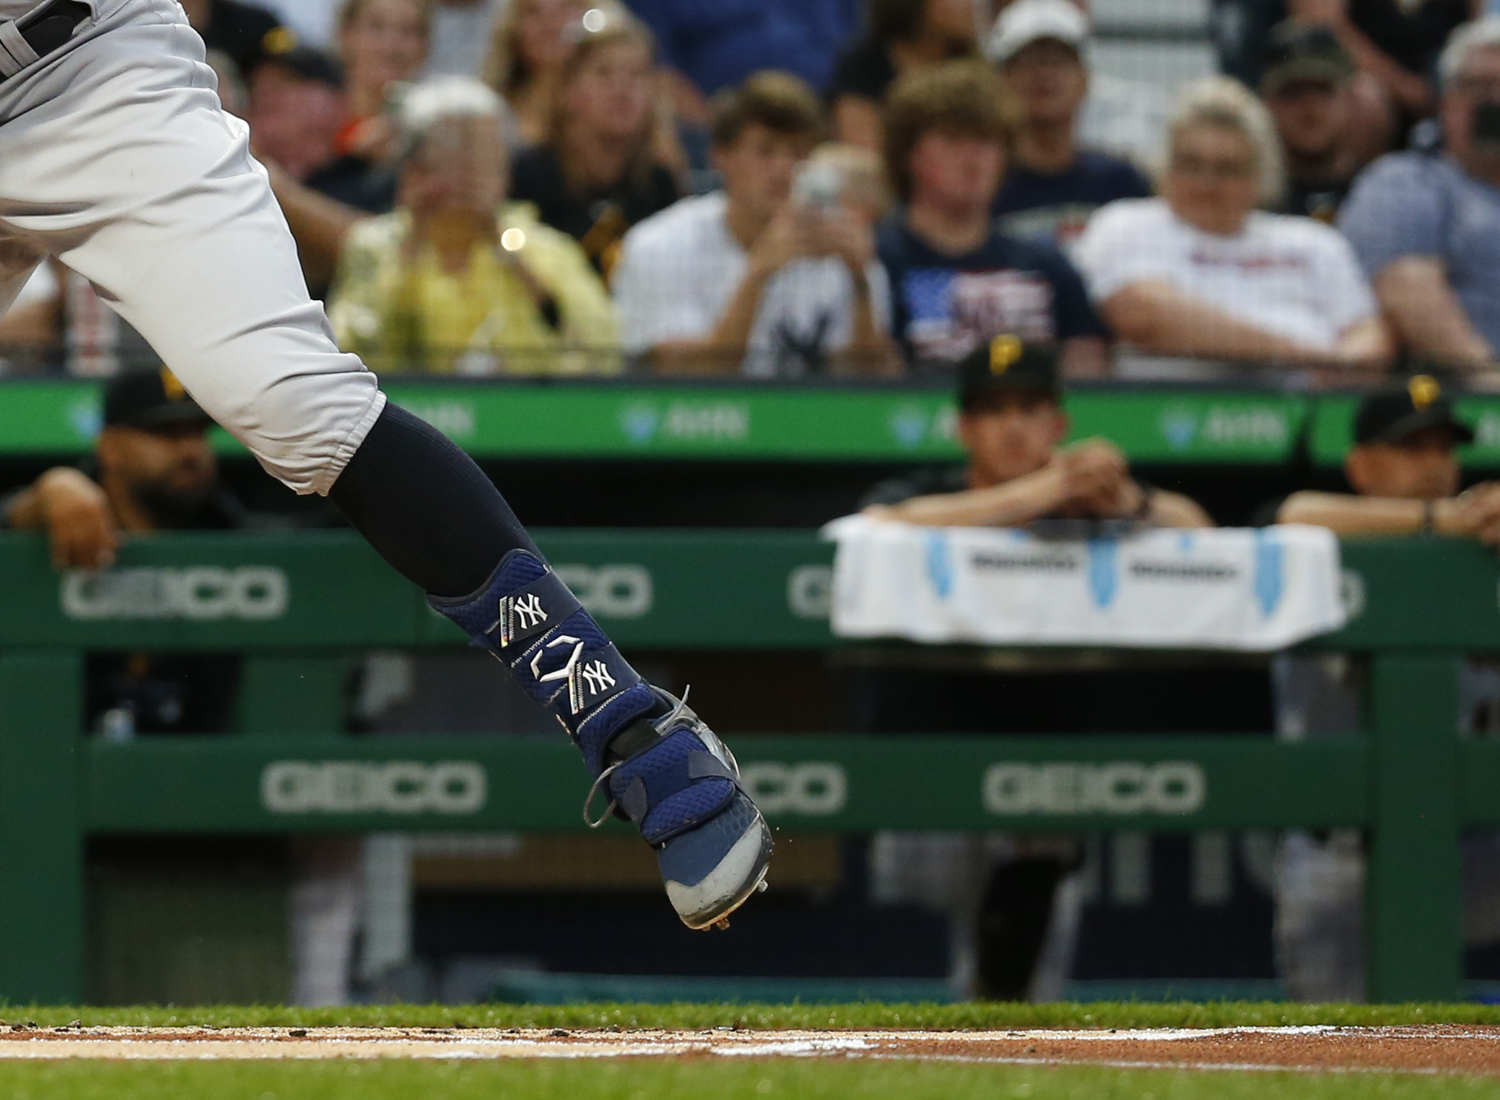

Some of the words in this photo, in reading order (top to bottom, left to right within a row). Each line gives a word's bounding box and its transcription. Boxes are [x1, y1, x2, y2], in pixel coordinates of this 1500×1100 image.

[989, 334, 1023, 376] P
[62, 566, 288, 620] GEICO
[514, 593, 548, 630] NY
[582, 659, 616, 696] NY
[262, 761, 487, 815] GEICO
[983, 762, 1205, 814] GEICO
